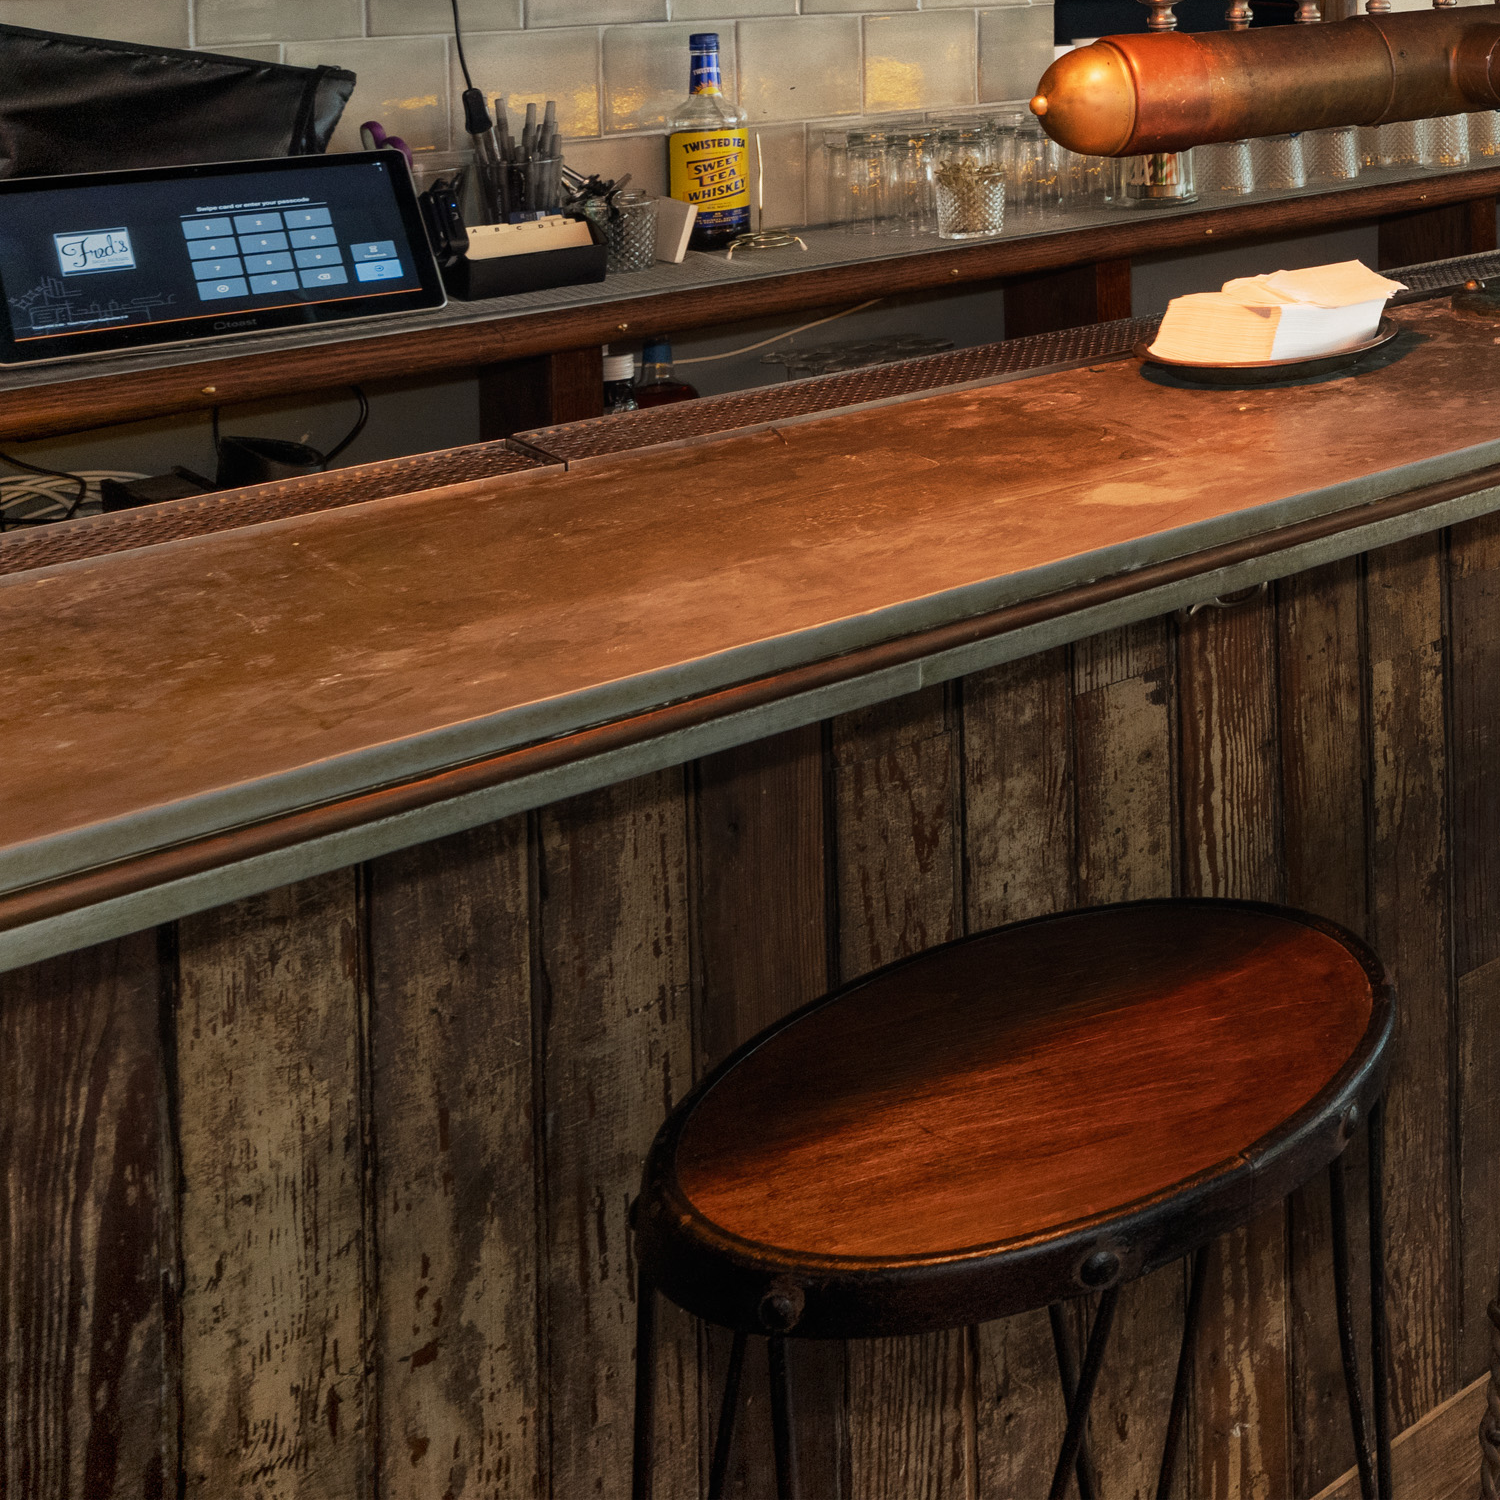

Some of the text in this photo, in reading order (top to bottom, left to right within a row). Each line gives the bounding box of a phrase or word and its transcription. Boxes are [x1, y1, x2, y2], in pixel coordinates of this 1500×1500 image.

[682, 137, 746, 154] TWISTED TEA
[694, 154, 740, 175] SWEET
[707, 168, 737, 182] TEA
[687, 176, 746, 202] WHISKEY
[196, 205, 218, 213] Swipe
[277, 196, 310, 205] passcode
[61, 234, 129, 268] Fred's
[225, 318, 257, 329] toast
